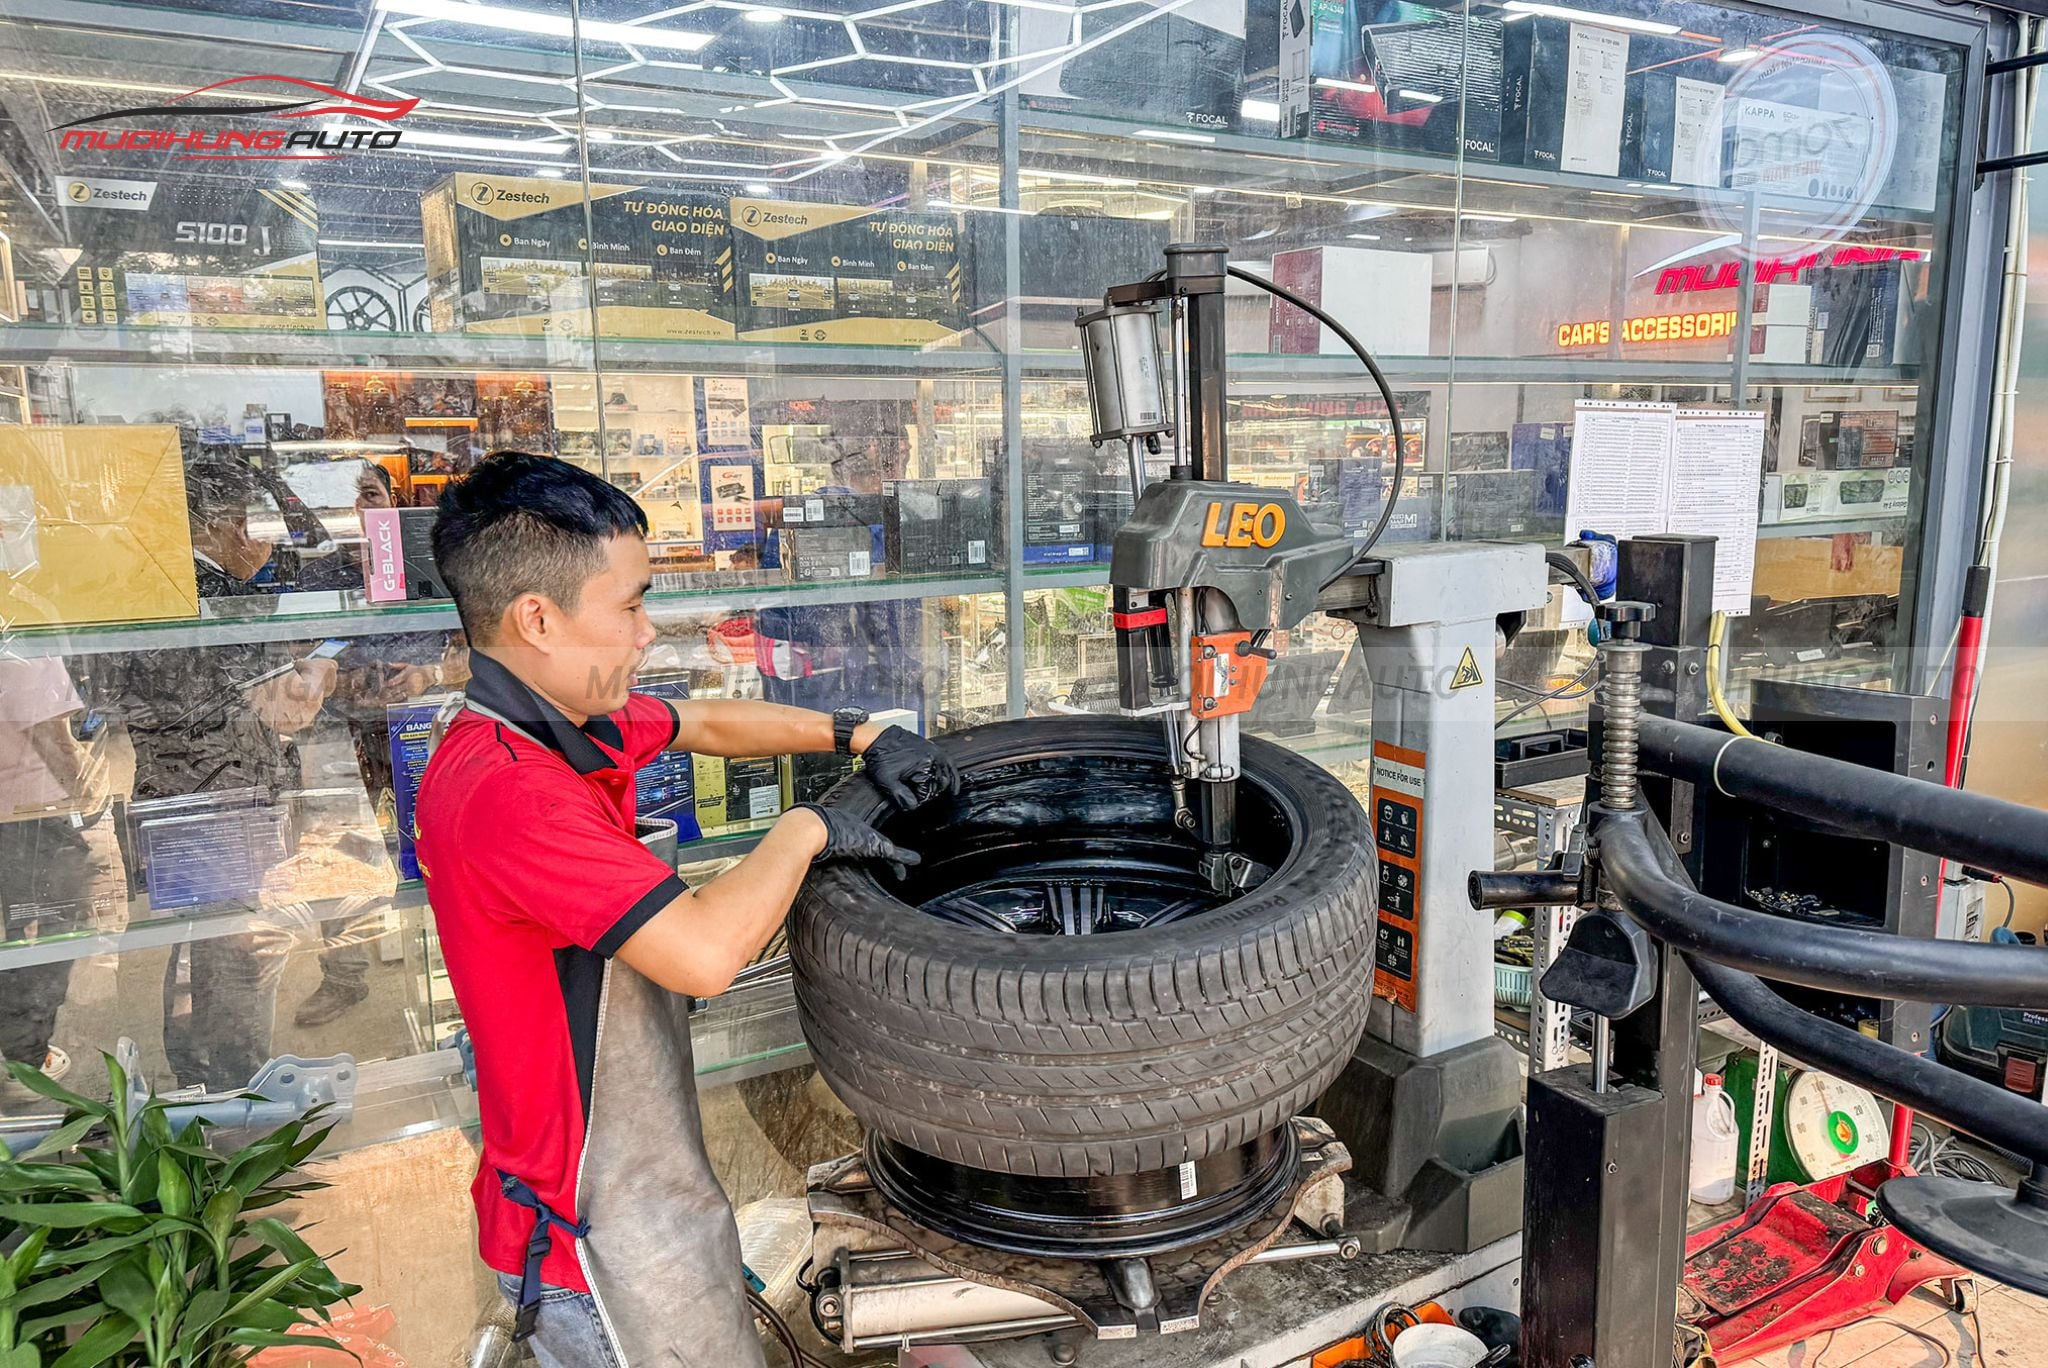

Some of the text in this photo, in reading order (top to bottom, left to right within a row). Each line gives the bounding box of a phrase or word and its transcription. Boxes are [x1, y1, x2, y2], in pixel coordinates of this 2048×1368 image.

[1196, 114, 1228, 124] FOCAL
[1745, 105, 1775, 119] KAPPA
[1465, 139, 1494, 152] FOCAL
[94, 187, 147, 202] Zestech
[496, 189, 550, 204] Zestech
[623, 200, 645, 216] TỰ
[763, 212, 808, 226] Zestech
[651, 219, 725, 237] GIAO DIỆN
[514, 237, 529, 246] Ban
[610, 243, 630, 252] Minh
[893, 239, 923, 250] GIAO
[669, 247, 683, 255] Ban
[1558, 310, 1738, 347] CAR'S ACCESSORI
[1202, 502, 1286, 548] LEO
[378, 520, 396, 591] G-BLACK
[1376, 767, 1421, 787] NOTICE FOR USE
